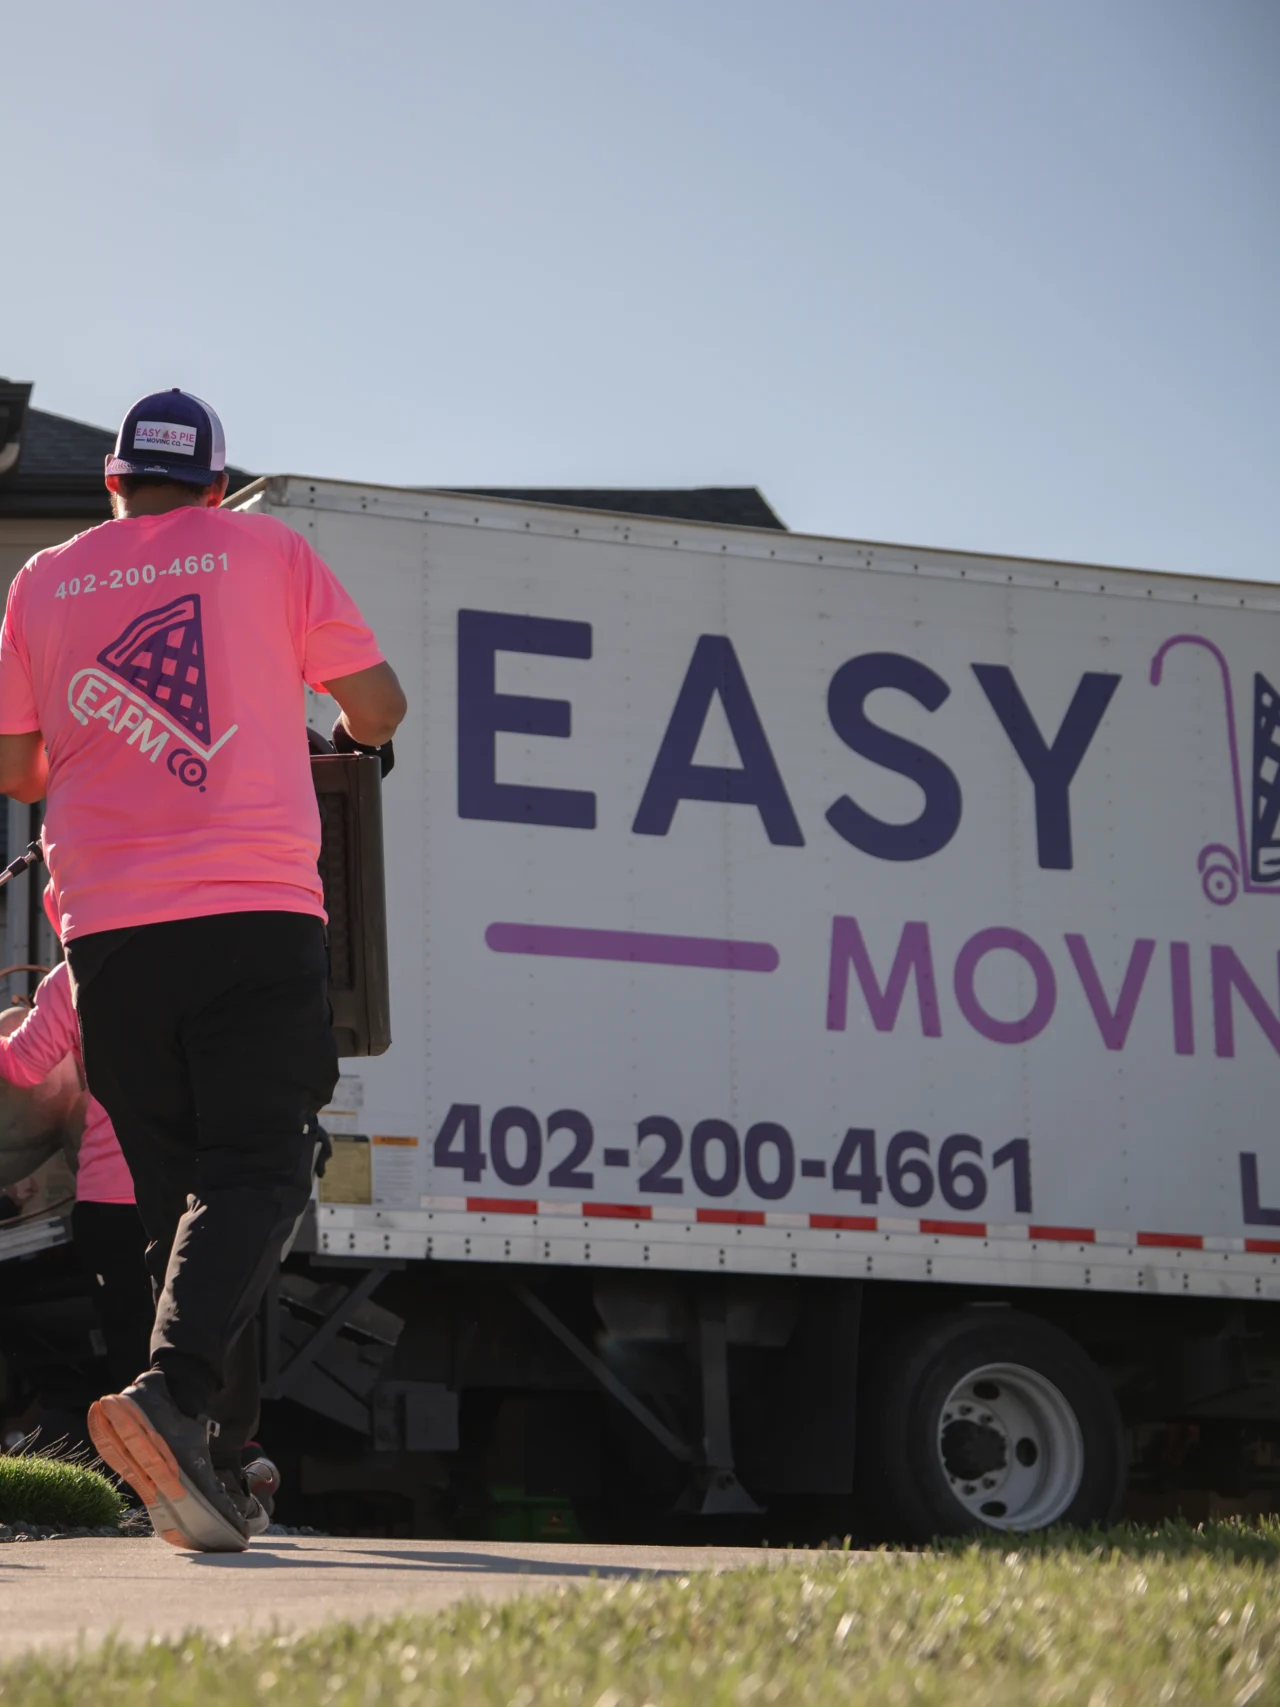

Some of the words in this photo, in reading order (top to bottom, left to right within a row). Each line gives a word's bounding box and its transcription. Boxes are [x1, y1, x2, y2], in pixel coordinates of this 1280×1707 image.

[135, 428, 161, 437] EASY
[179, 432, 195, 443] PIE
[54, 552, 228, 599] 402-200-4661
[76, 677, 169, 763] EAPM
[457, 609, 1122, 870] EASY
[434, 1104, 1032, 1214] 402-200-4661
